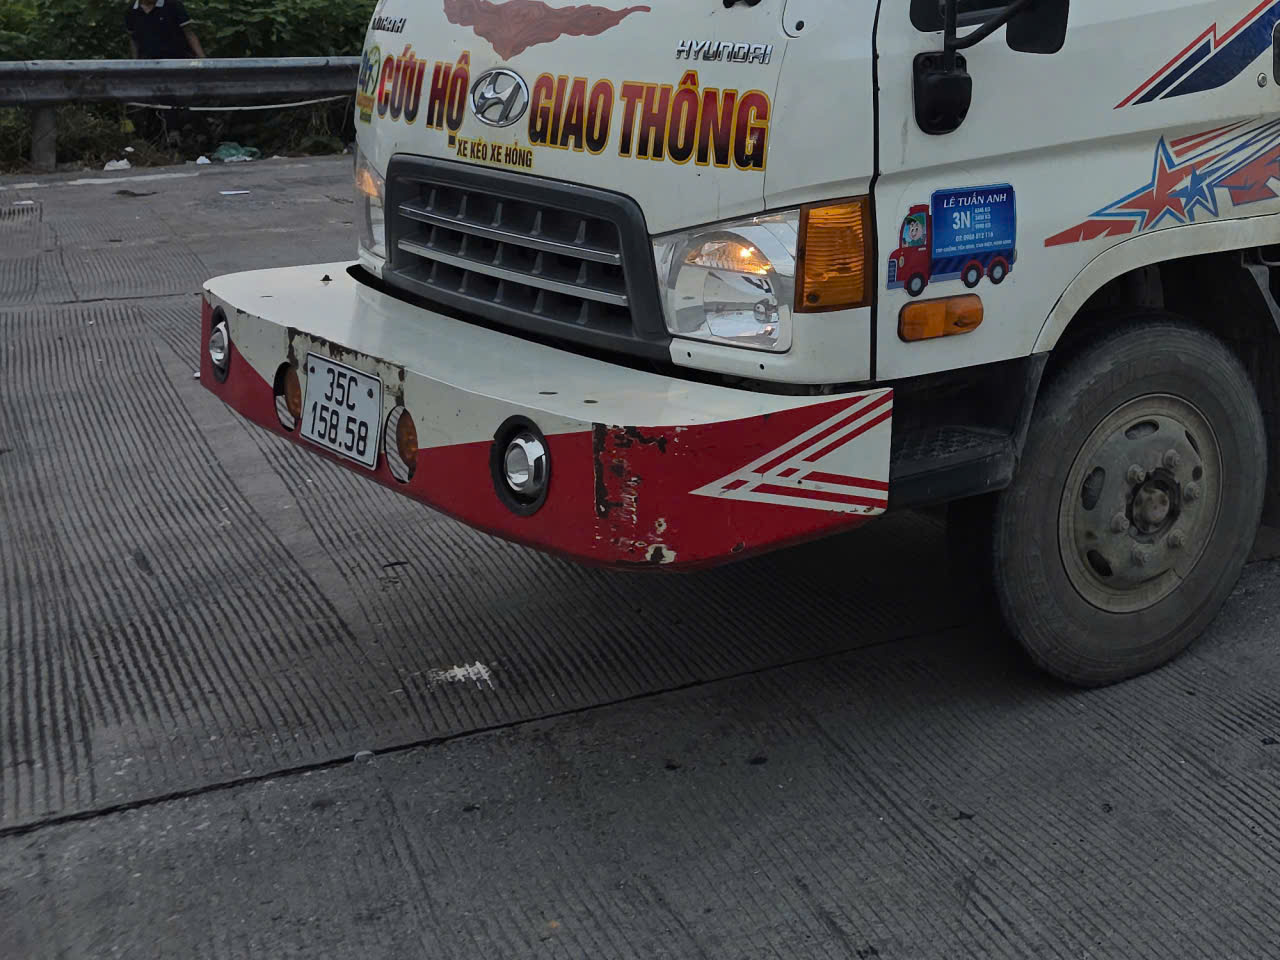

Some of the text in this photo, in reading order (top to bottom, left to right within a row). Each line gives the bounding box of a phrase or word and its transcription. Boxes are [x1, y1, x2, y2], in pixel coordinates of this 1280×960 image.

[676, 40, 773, 65] HYUNDAI
[377, 43, 771, 171] CỨU HỘ GIAO THÔNG
[457, 139, 468, 157] XE
[490, 143, 502, 162] XE
[986, 193, 1007, 203] ANH
[953, 211, 971, 230] 3N
[324, 367, 358, 411] 35C
[311, 401, 369, 457] 158.58
